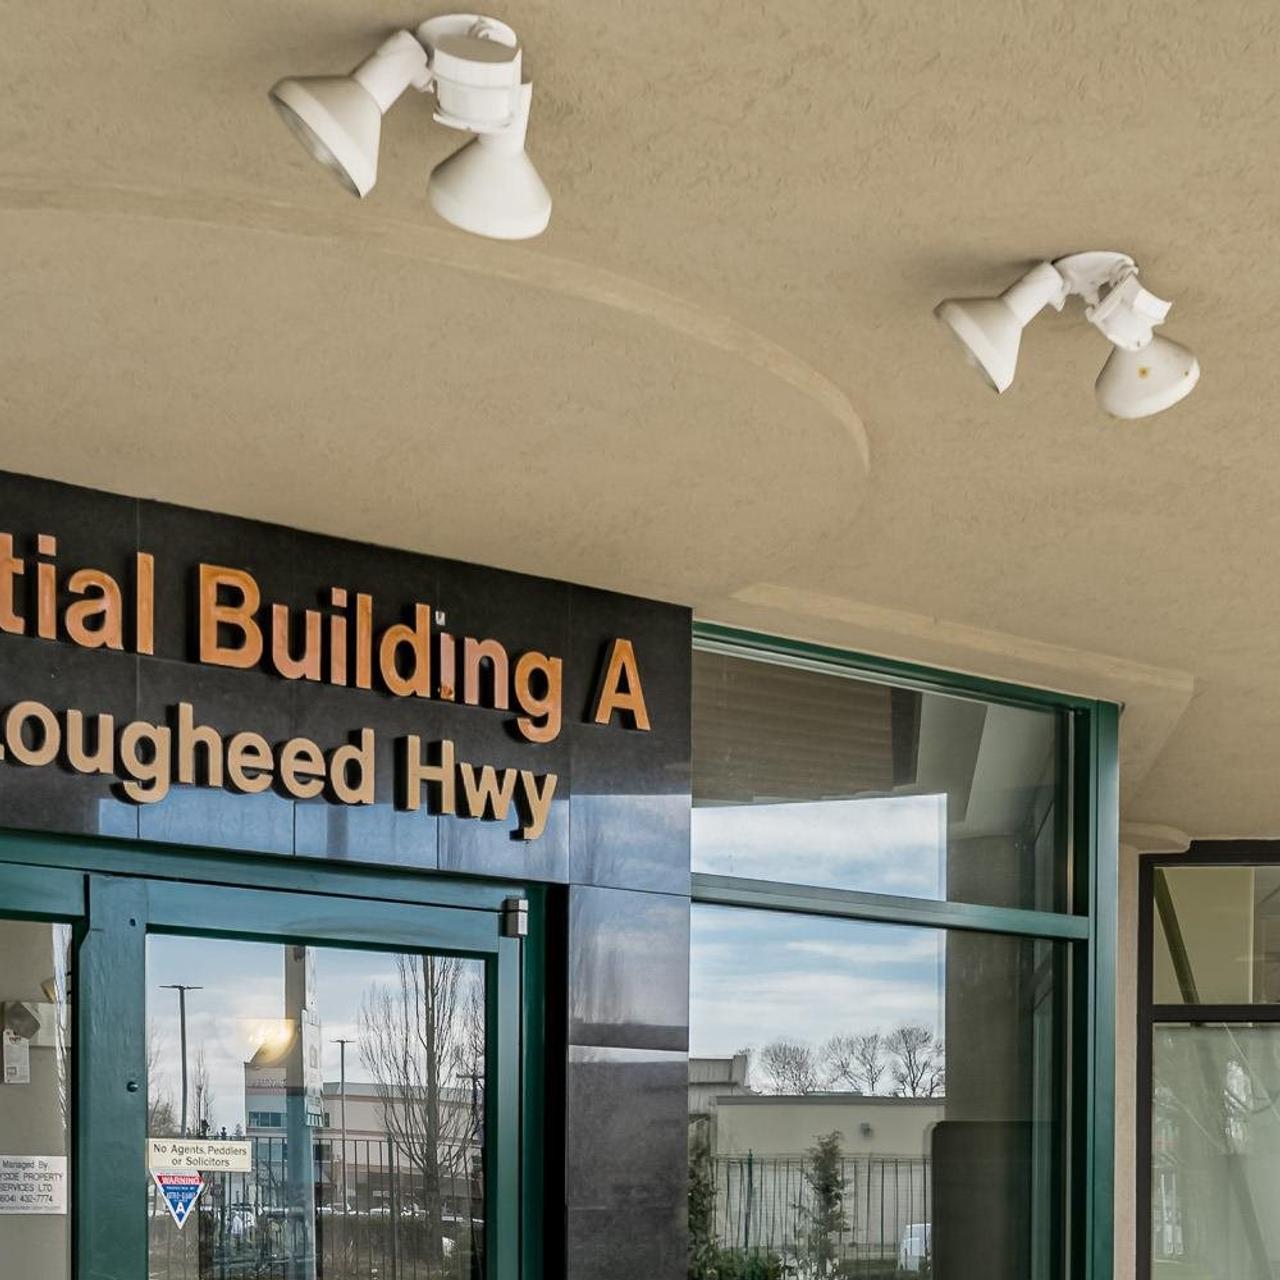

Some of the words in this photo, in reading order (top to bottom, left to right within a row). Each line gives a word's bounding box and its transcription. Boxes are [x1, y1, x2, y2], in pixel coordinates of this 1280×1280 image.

[199, 563, 563, 743] Building
[594, 638, 651, 731] A
[407, 734, 558, 841] Hwy
[153, 1143, 167, 1153] No
[207, 1145, 248, 1156] Peddlers
[2, 1159, 35, 1171] Managed
[171, 1158, 182, 1167] or
[185, 1155, 231, 1168] Solicitors
[22, 1172, 64, 1182] PROPERTY
